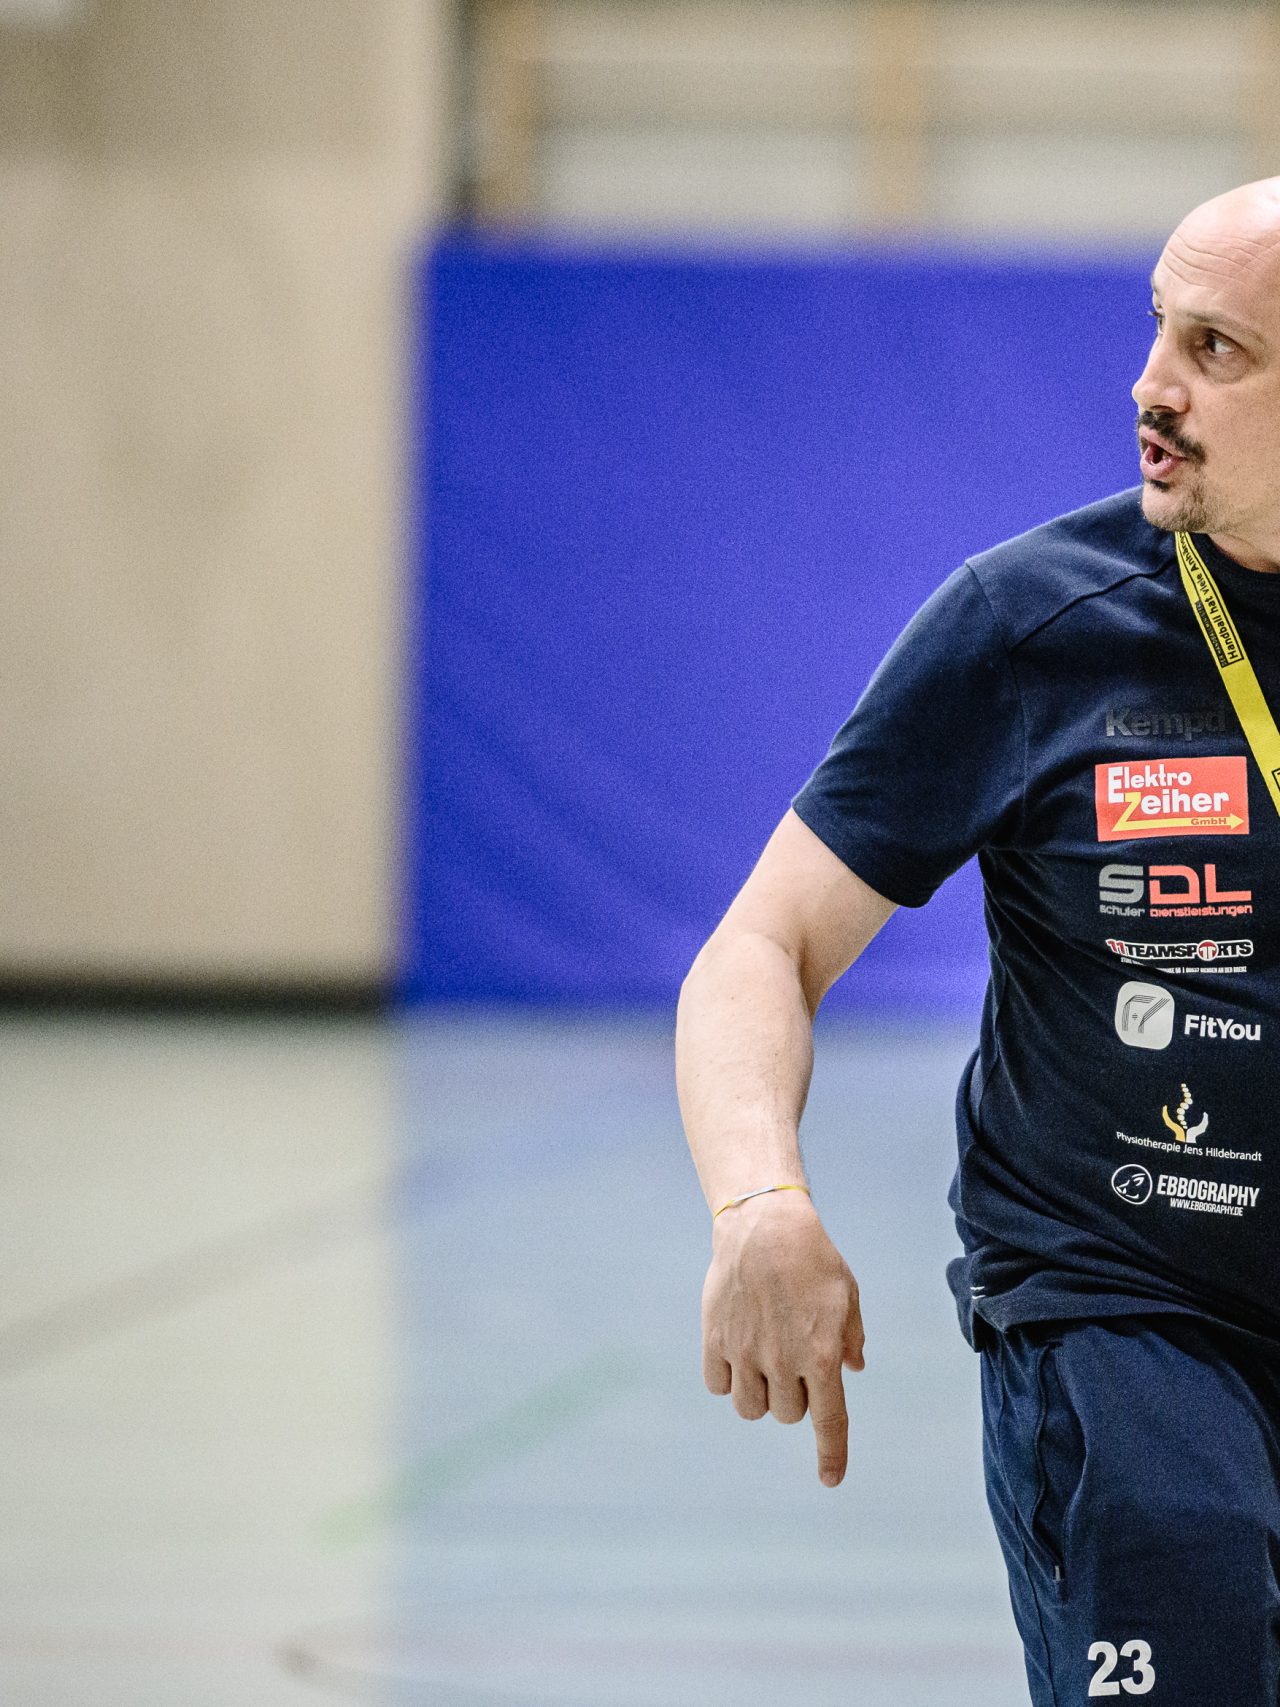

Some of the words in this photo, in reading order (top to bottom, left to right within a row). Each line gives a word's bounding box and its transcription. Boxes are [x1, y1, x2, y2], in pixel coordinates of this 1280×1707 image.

[1196, 574, 1209, 595] viele
[1205, 596, 1219, 614] hat
[1212, 615, 1238, 659] Handball
[1106, 708, 1226, 741] Kempa
[1108, 764, 1192, 803] Elektro
[1111, 789, 1229, 832] Zeiher
[1099, 864, 1252, 904] SDL
[1184, 1014, 1261, 1041] FitYou
[1116, 1132, 1180, 1153] Physiotherapie
[1182, 1144, 1203, 1155] Jens
[1205, 1147, 1262, 1161] Hildebrandt
[1157, 1174, 1260, 1207] EBBOGRAPHY
[1170, 1198, 1243, 1216] WWW.EBBOGRAPHY.DE
[1087, 1639, 1156, 1697] 23
